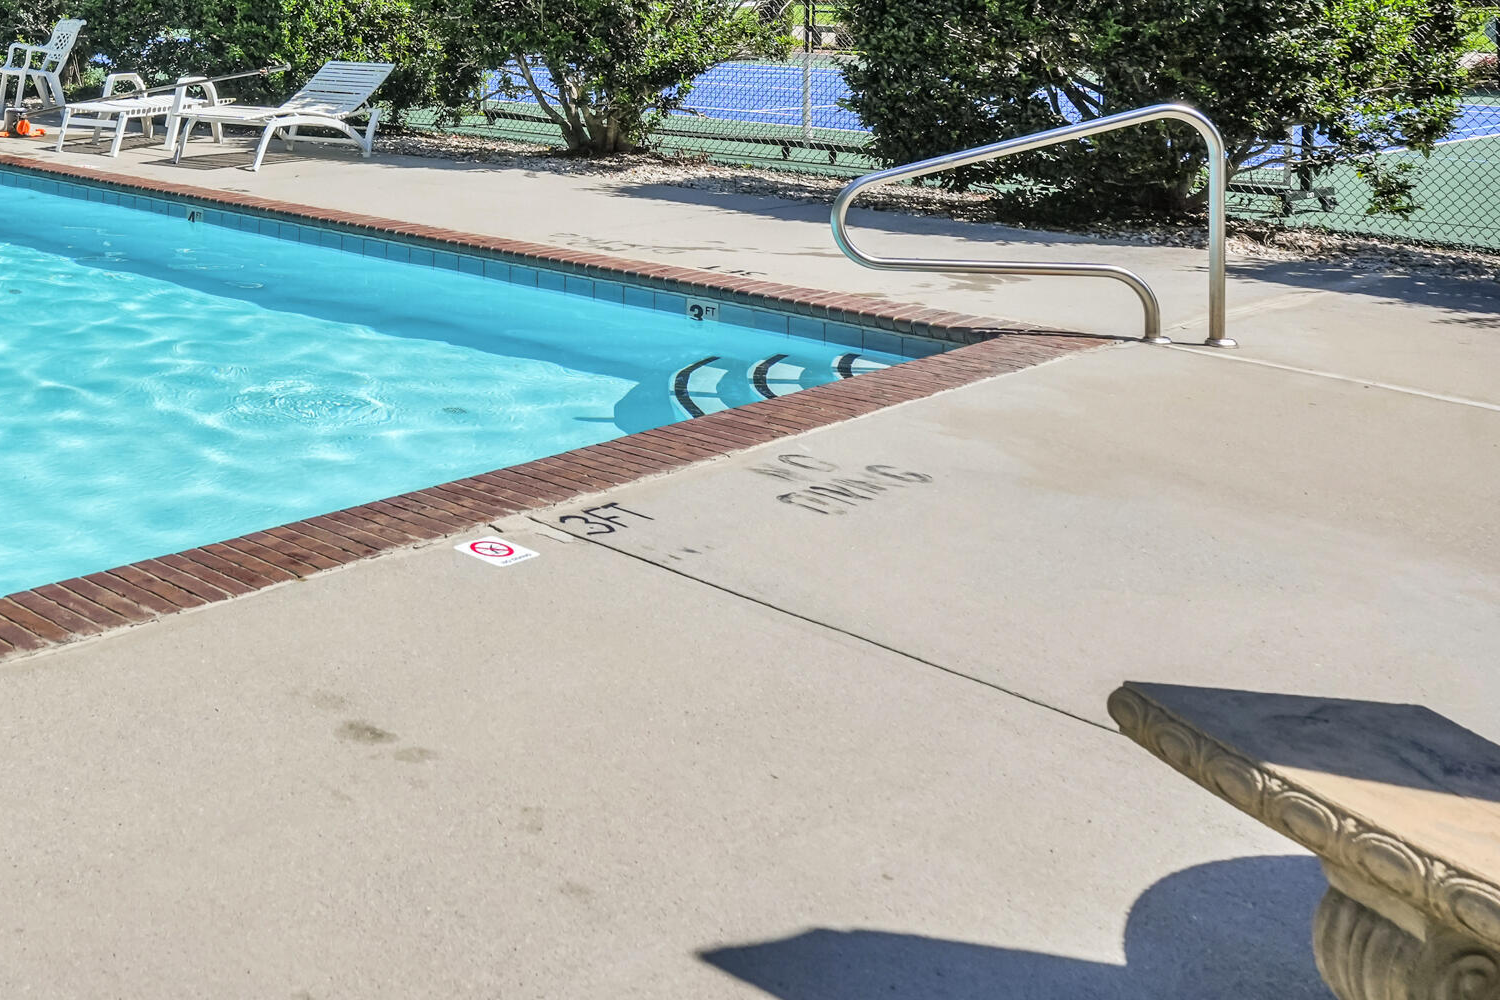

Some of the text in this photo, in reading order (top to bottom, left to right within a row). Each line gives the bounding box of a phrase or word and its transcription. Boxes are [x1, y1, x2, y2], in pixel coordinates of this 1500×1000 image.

[690, 304, 716, 321] 3 FT
[559, 502, 654, 536] 3FT
